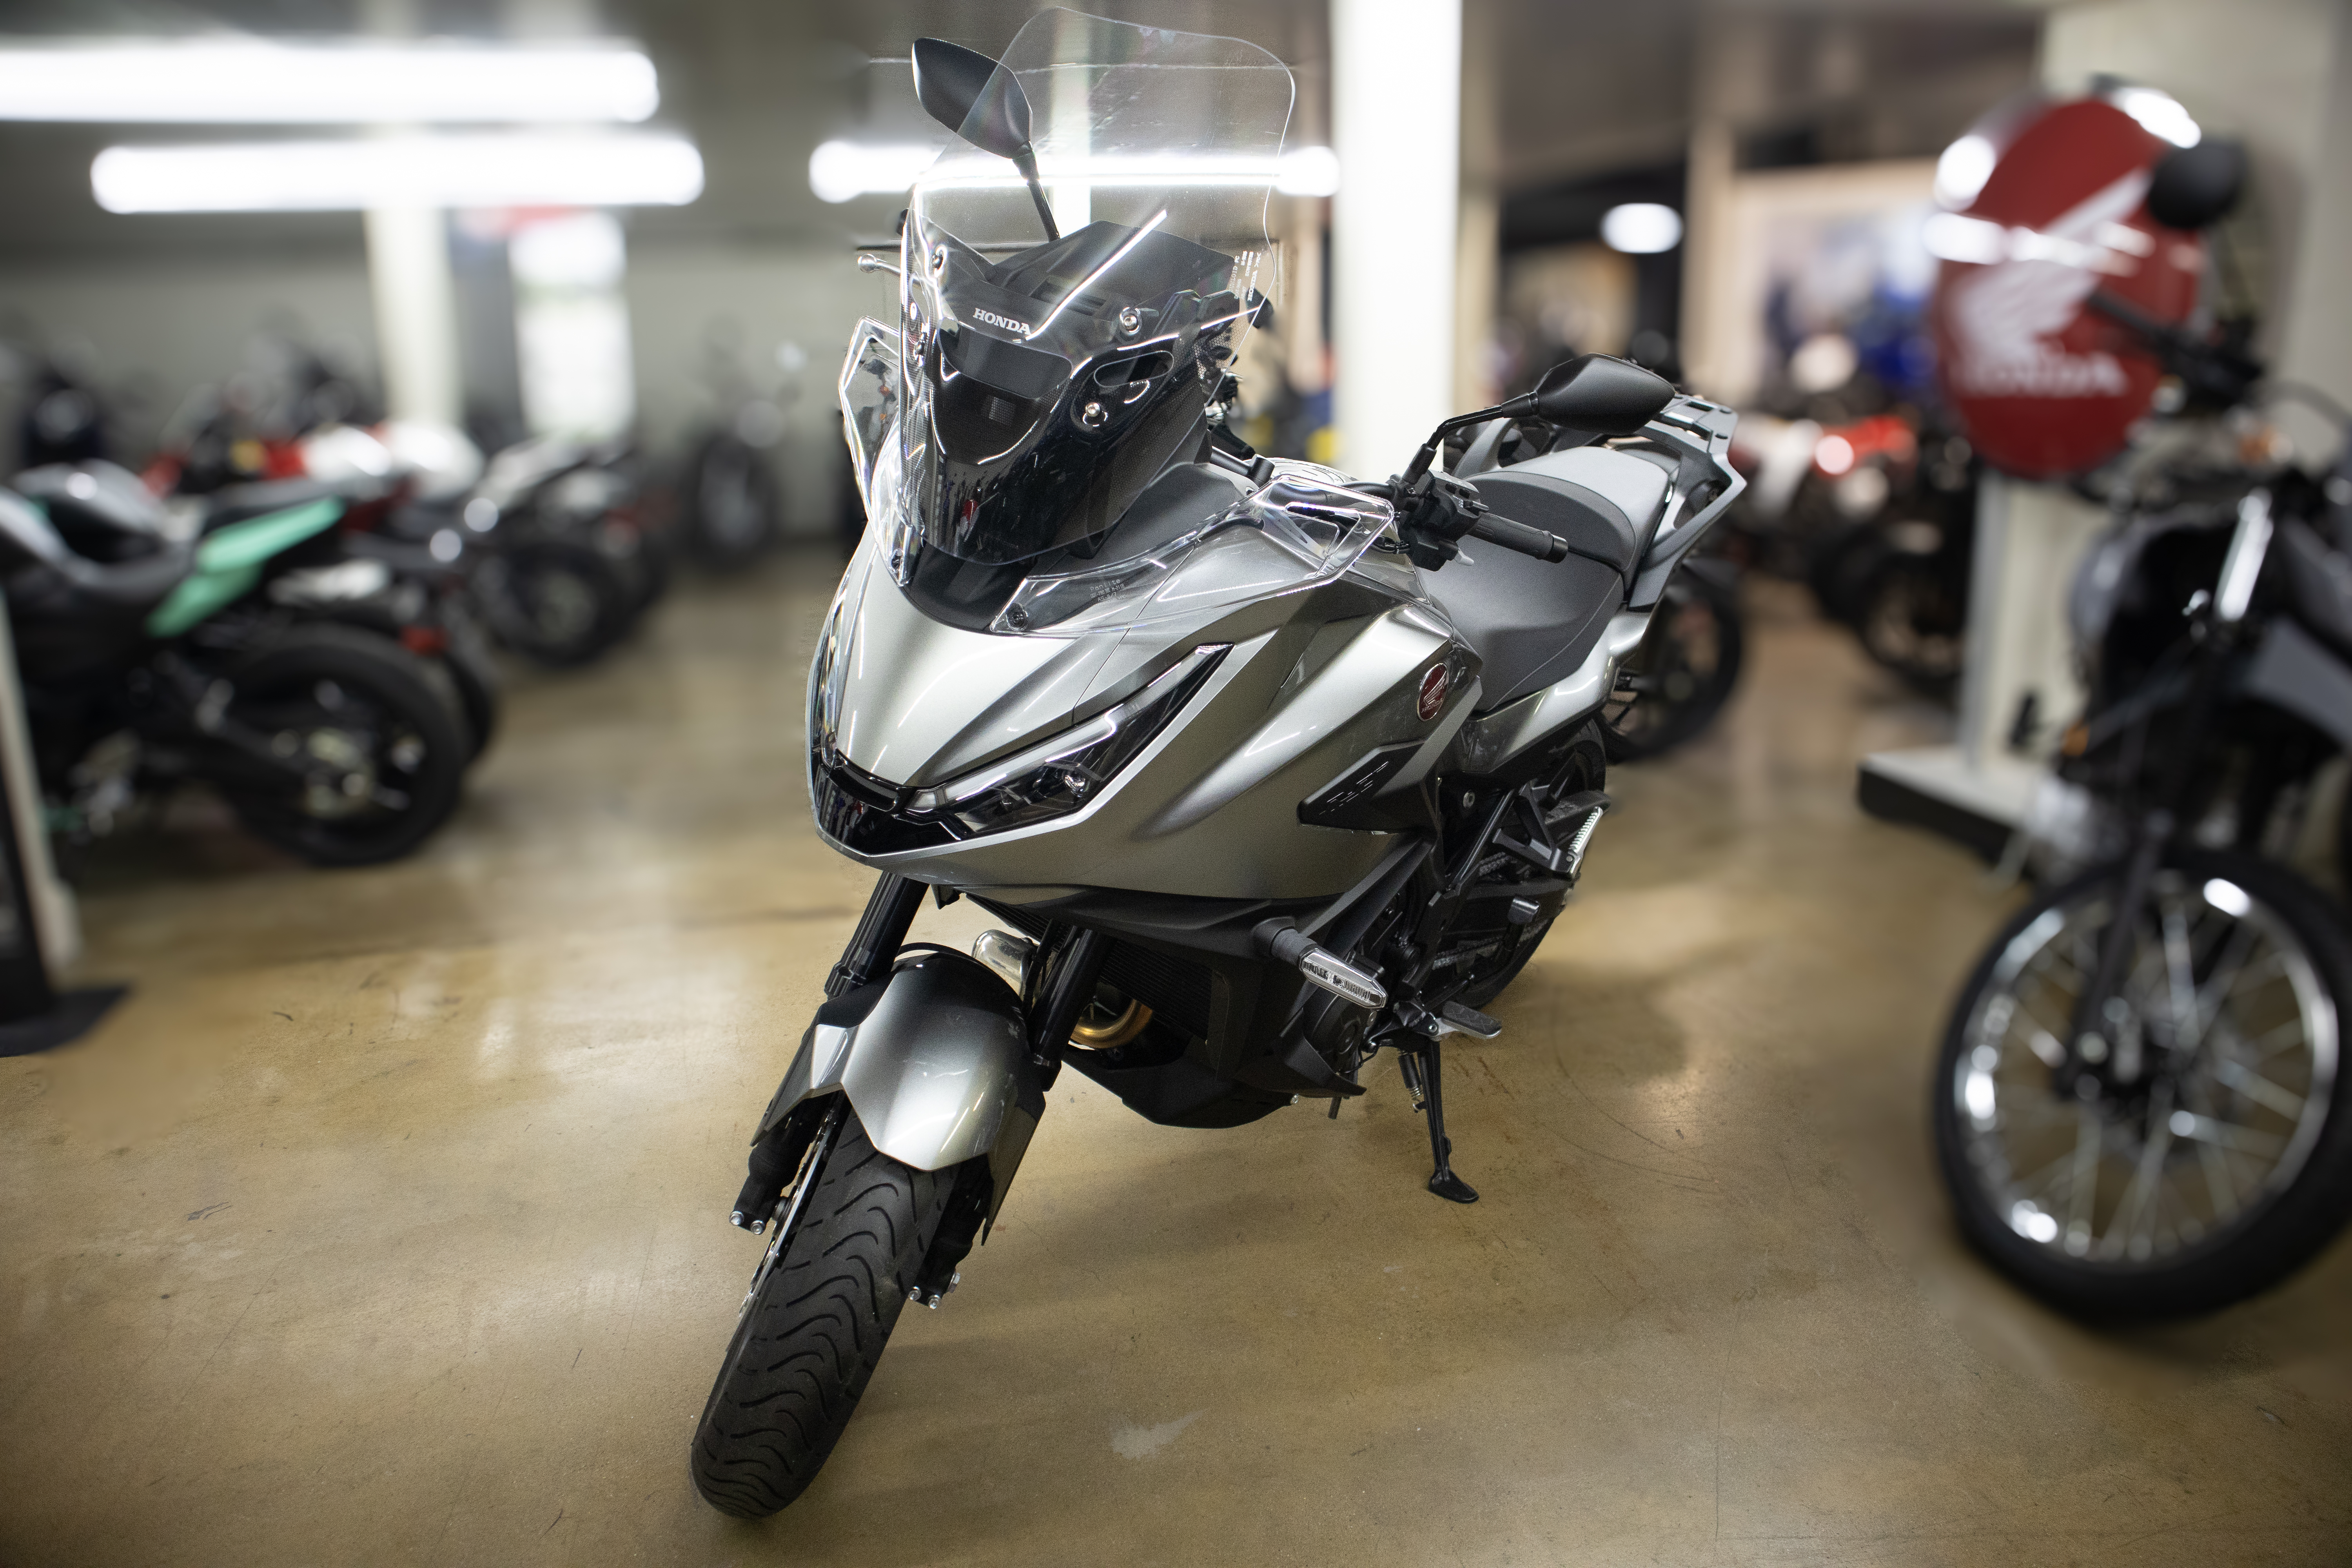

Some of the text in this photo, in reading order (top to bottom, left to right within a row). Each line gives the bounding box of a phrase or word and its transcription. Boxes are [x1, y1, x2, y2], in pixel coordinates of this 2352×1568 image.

[1247, 270, 1258, 302] HONDA
[973, 307, 1032, 335] HONDA
[1090, 579, 1120, 591] Panlite
